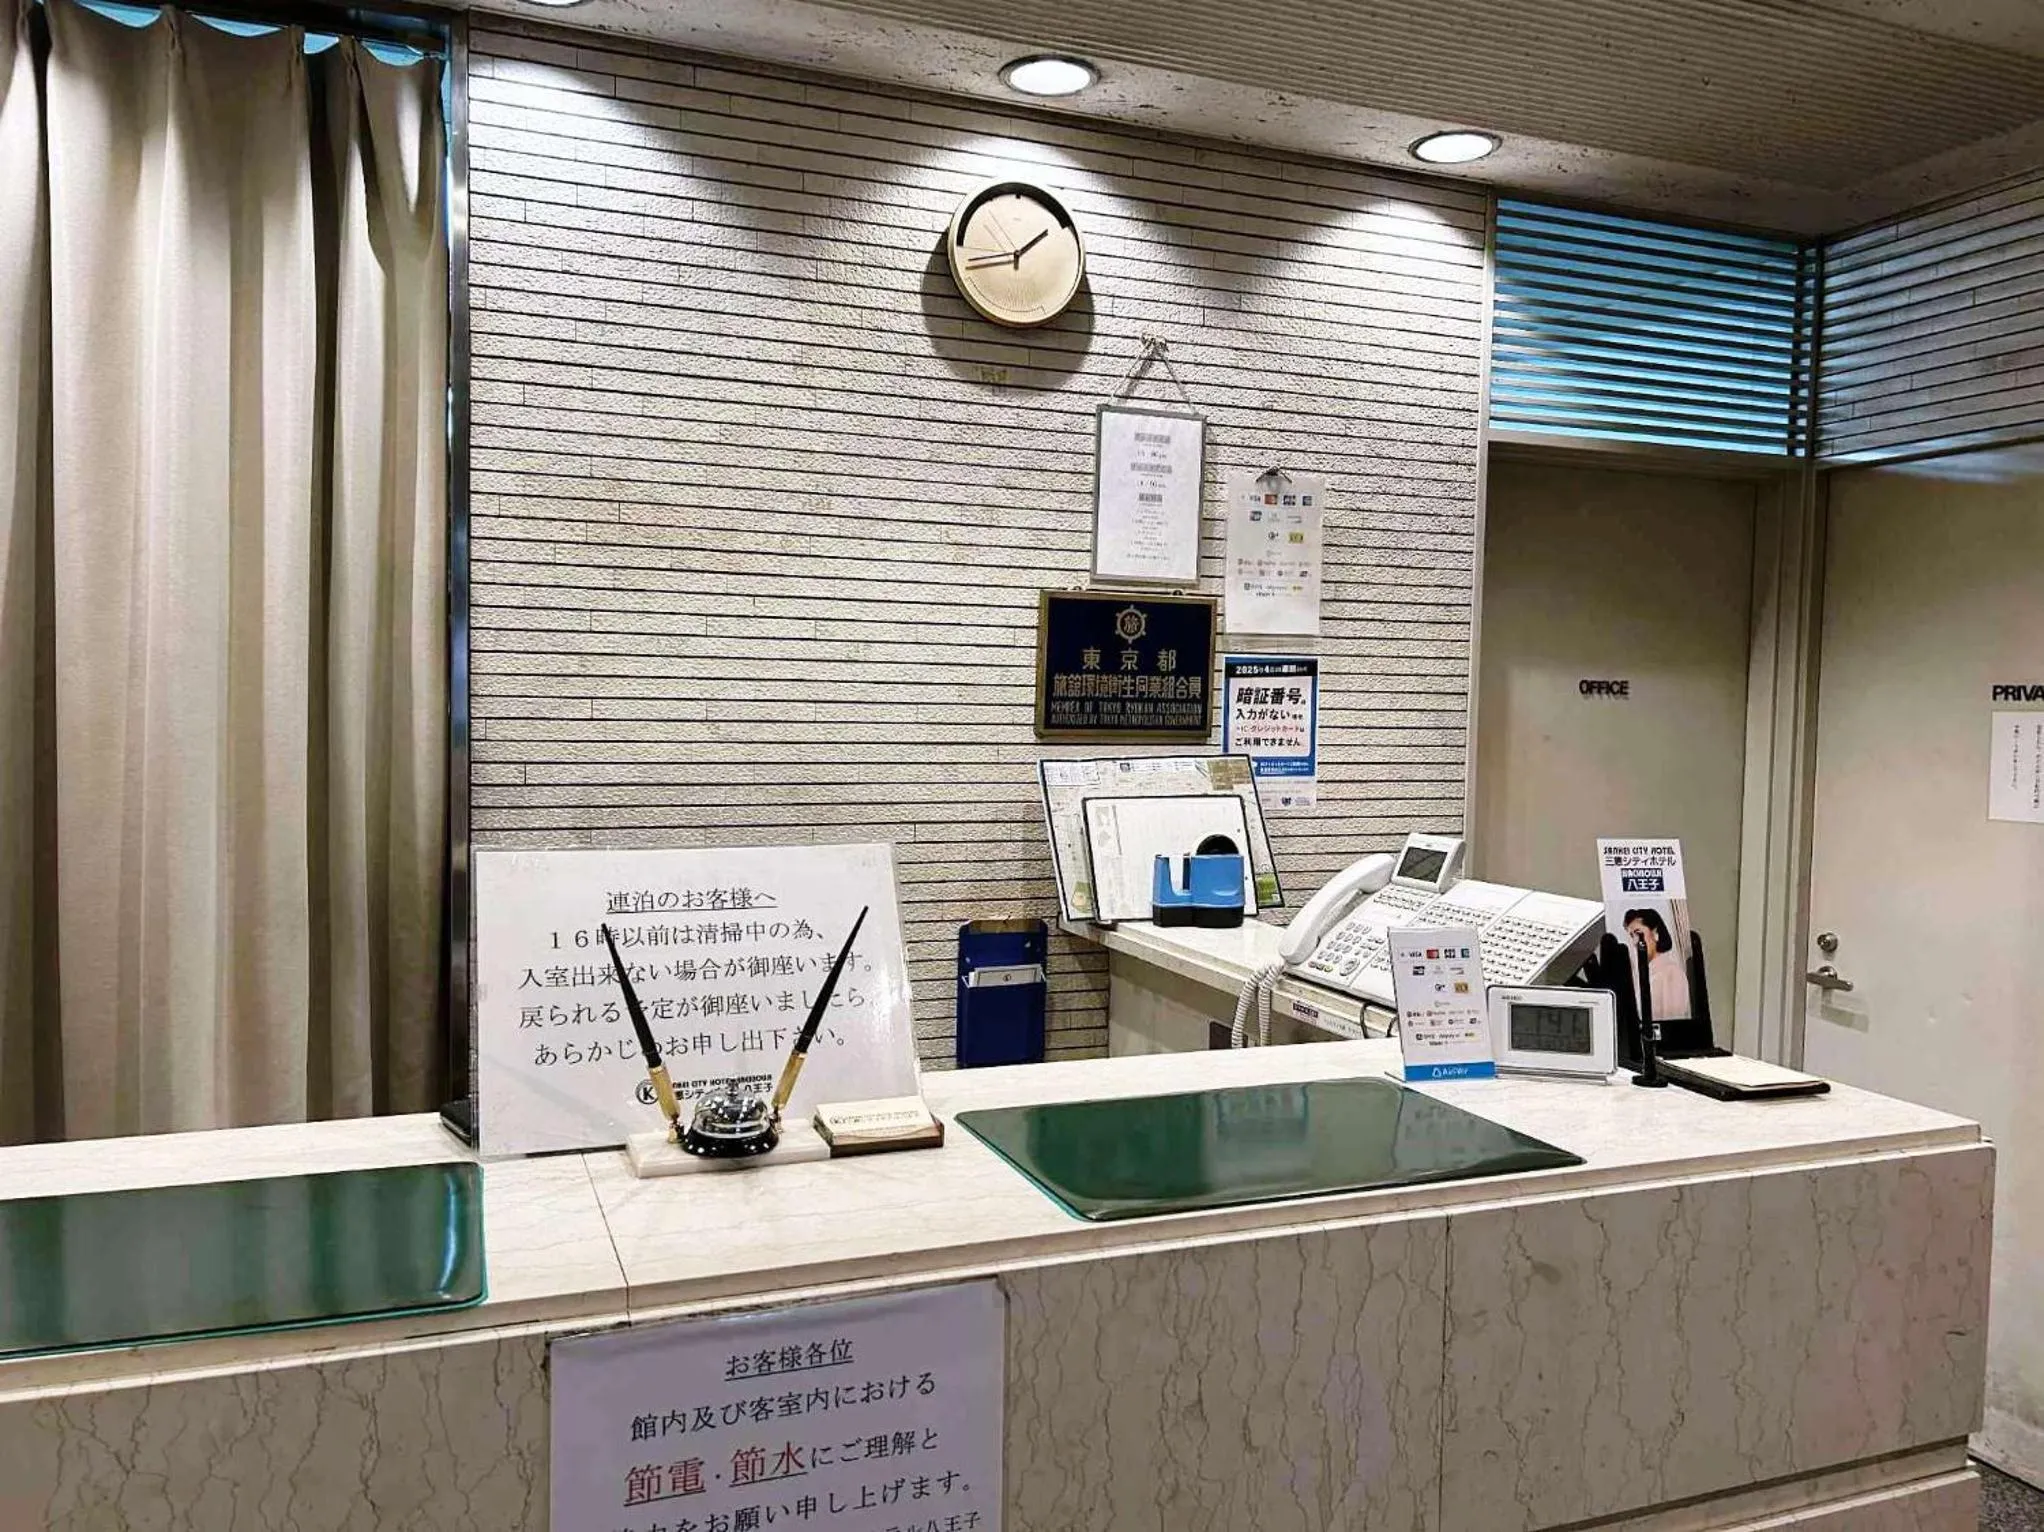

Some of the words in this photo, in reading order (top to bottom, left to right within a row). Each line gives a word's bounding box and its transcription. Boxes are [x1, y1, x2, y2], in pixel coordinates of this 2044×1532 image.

[1579, 680, 1629, 696] OFFICE
[1099, 701, 1121, 713] TOKYO
[1632, 846, 1649, 855] CITY
[1650, 846, 1675, 855] HOTEL
[1628, 879, 1660, 891] 八王子
[606, 886, 777, 913] 連泊のお客様へ
[725, 1339, 853, 1377] お客様各位
[631, 1372, 936, 1441] 館内及び客室内における
